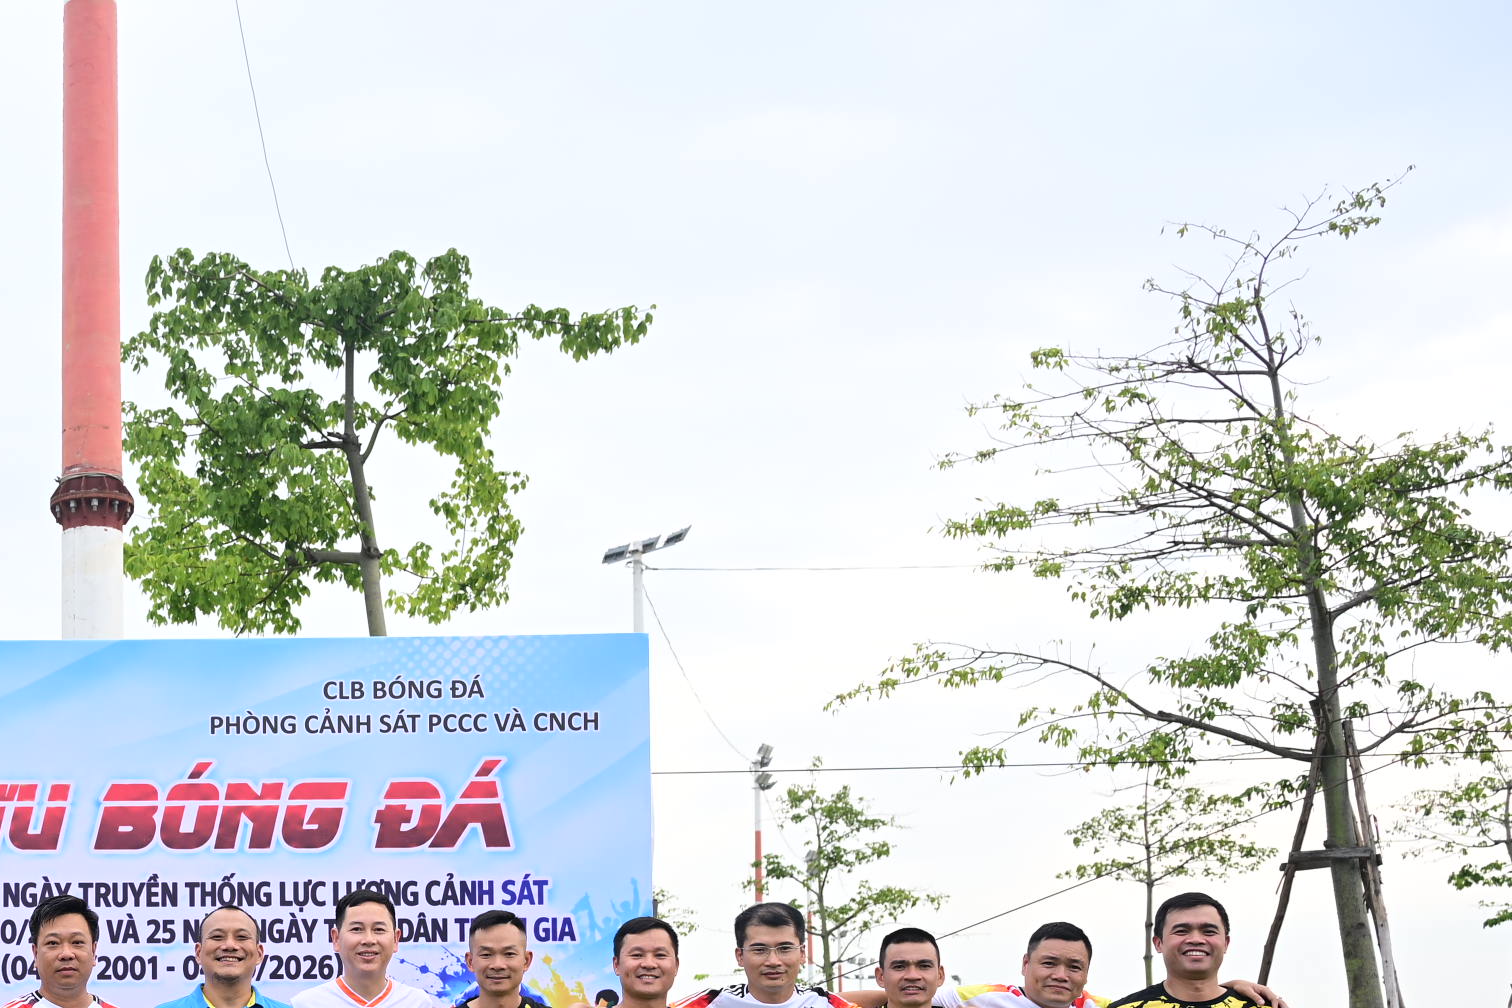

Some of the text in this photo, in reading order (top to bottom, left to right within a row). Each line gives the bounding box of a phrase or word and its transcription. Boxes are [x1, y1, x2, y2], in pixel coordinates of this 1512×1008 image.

[323, 675, 485, 700] CLB BÓNG ĐÁ
[210, 707, 599, 735] PHÒNG CẢNH SÁT PCCC VÀ CNCH
[93, 761, 349, 850] BÓNG
[374, 759, 512, 849] ĐÁ
[77, 873, 179, 908] TRUYỀN
[184, 872, 273, 908] THỐNG
[279, 878, 327, 913] LỰC
[424, 873, 495, 907] CẢNH
[500, 874, 549, 906] SÁT
[106, 913, 141, 944] VÀ
[146, 919, 176, 944] 25
[397, 912, 448, 943] DÂN
[533, 917, 577, 942] GIA
